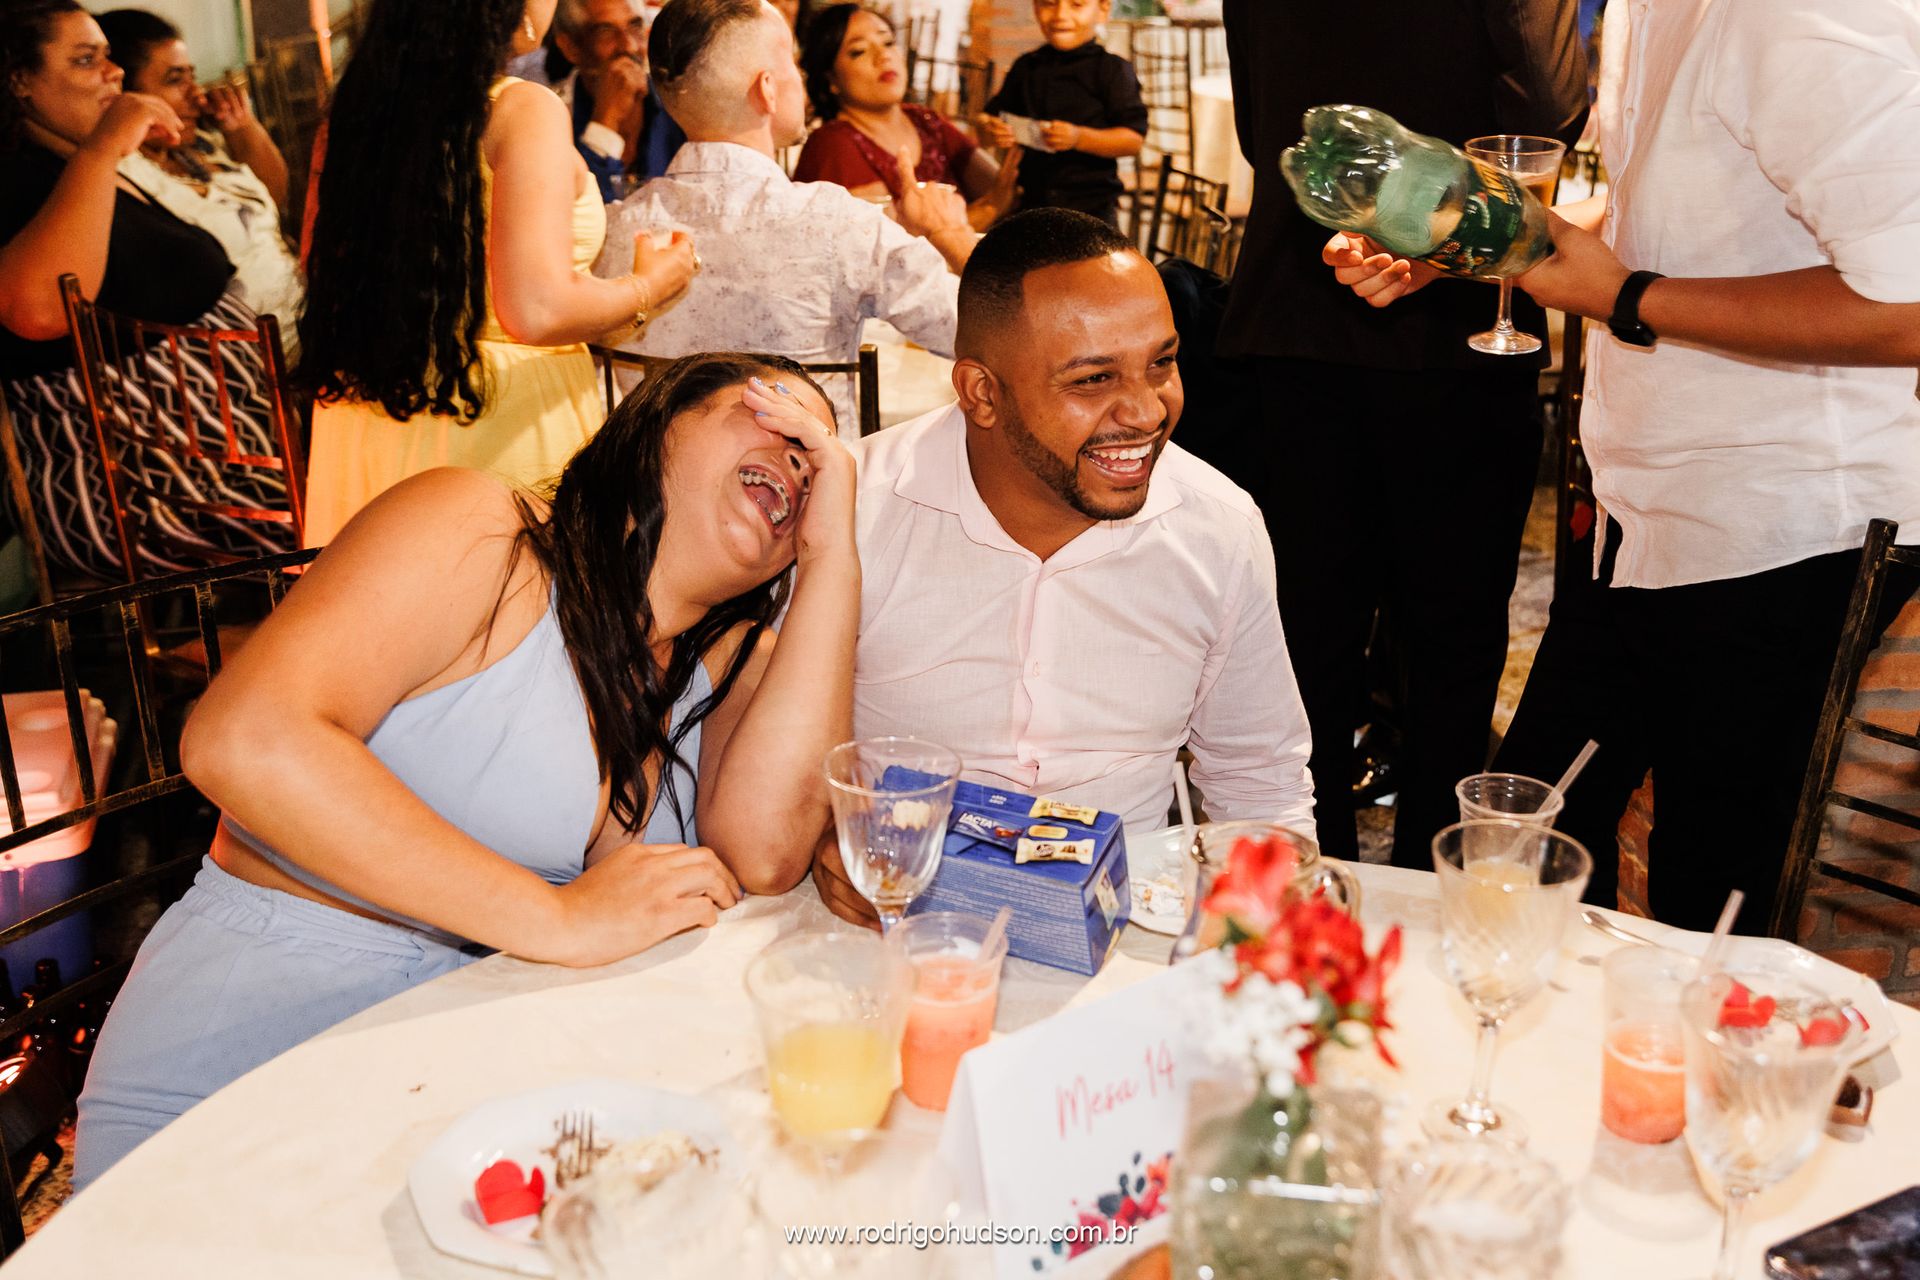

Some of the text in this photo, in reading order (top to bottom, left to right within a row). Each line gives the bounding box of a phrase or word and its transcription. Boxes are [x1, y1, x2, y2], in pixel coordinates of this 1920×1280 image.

[958, 812, 993, 829] LACTA
[1055, 1039, 1176, 1140] Mesa 14
